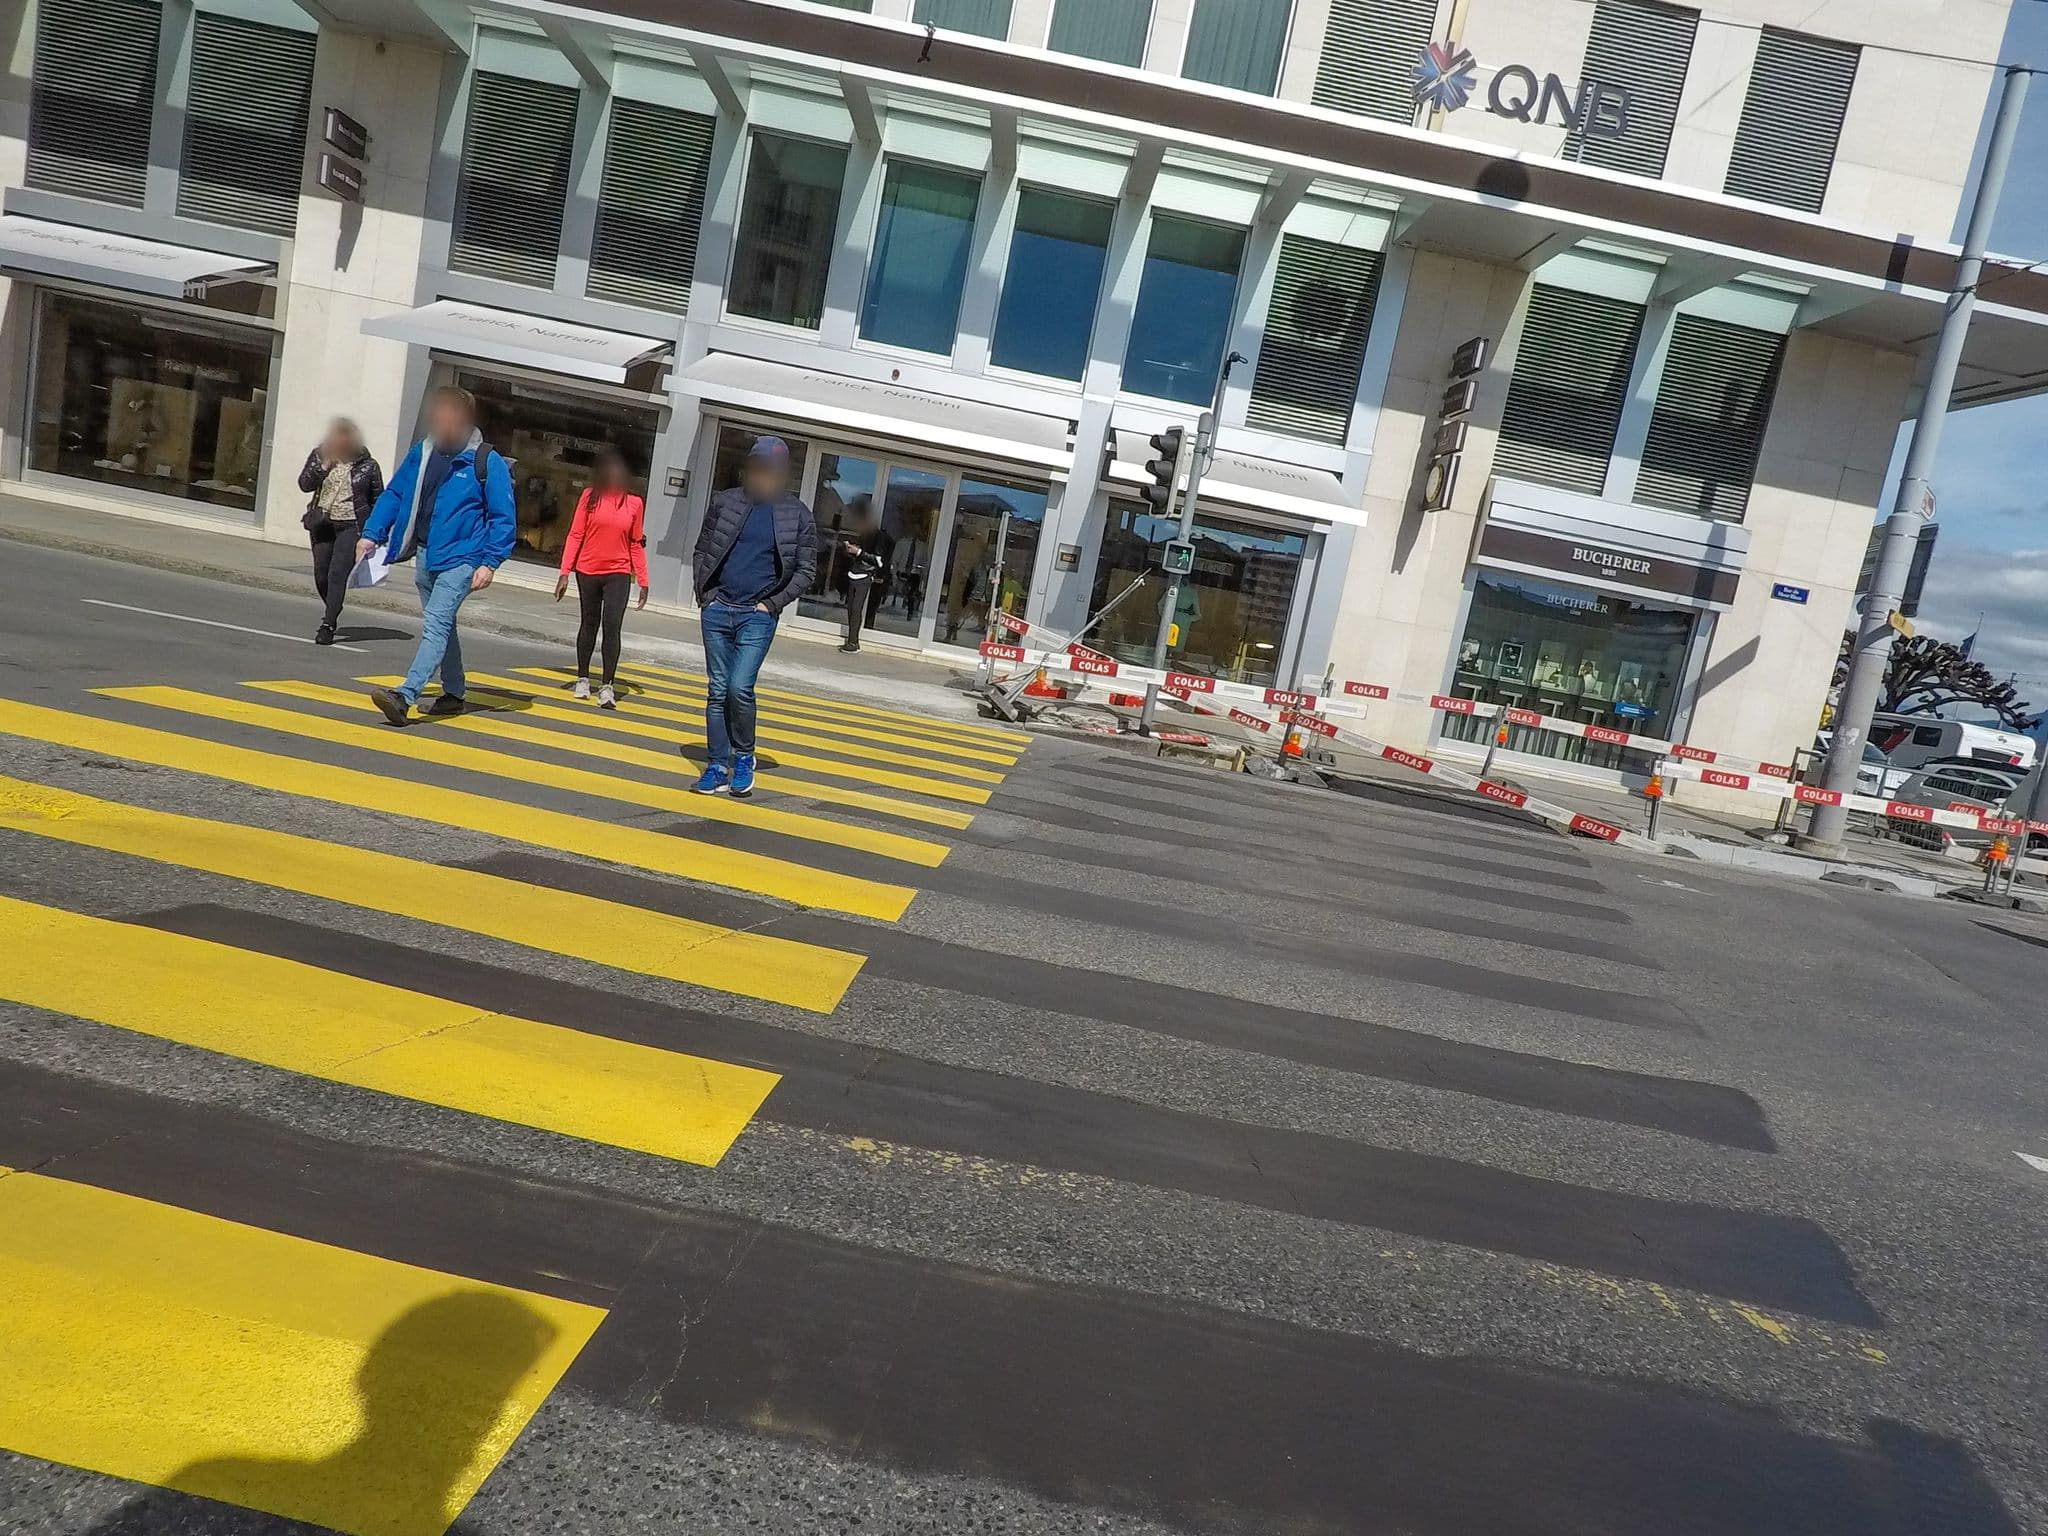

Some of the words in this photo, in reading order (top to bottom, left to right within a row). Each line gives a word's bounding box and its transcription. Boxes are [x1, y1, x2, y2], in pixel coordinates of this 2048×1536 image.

[1488, 64, 1632, 139] QNB
[447, 312, 522, 330] Franck
[528, 327, 608, 346] Namani
[803, 375, 874, 392] Franck
[884, 389, 961, 410] Namani
[1232, 459, 1309, 482] Namani
[1571, 547, 1651, 575] BUCHERER
[1547, 593, 1609, 614] BUCHERER
[1000, 615, 1022, 631] OLAS
[986, 646, 1018, 659] COLAS
[1078, 660, 1110, 674] COLAS
[1173, 675, 1207, 690] COLAS
[1351, 684, 1381, 698] COLAS
[1437, 698, 1468, 712] COLAS
[1235, 713, 1263, 730] COLAS
[1297, 715, 1329, 734] COLAS
[1505, 710, 1534, 724] COLAS
[1591, 729, 1622, 743] COLAS
[1391, 751, 1424, 769] COLAS
[1679, 747, 1708, 761] COLAS
[1767, 766, 1791, 778] COLA
[1709, 773, 1741, 787] COLAS
[1485, 786, 1518, 804] COLAS
[1802, 789, 1835, 803] COLAS
[1894, 805, 1926, 819] COLAS
[1579, 820, 1612, 837] COLAS
[1986, 821, 2017, 835] COLAS
